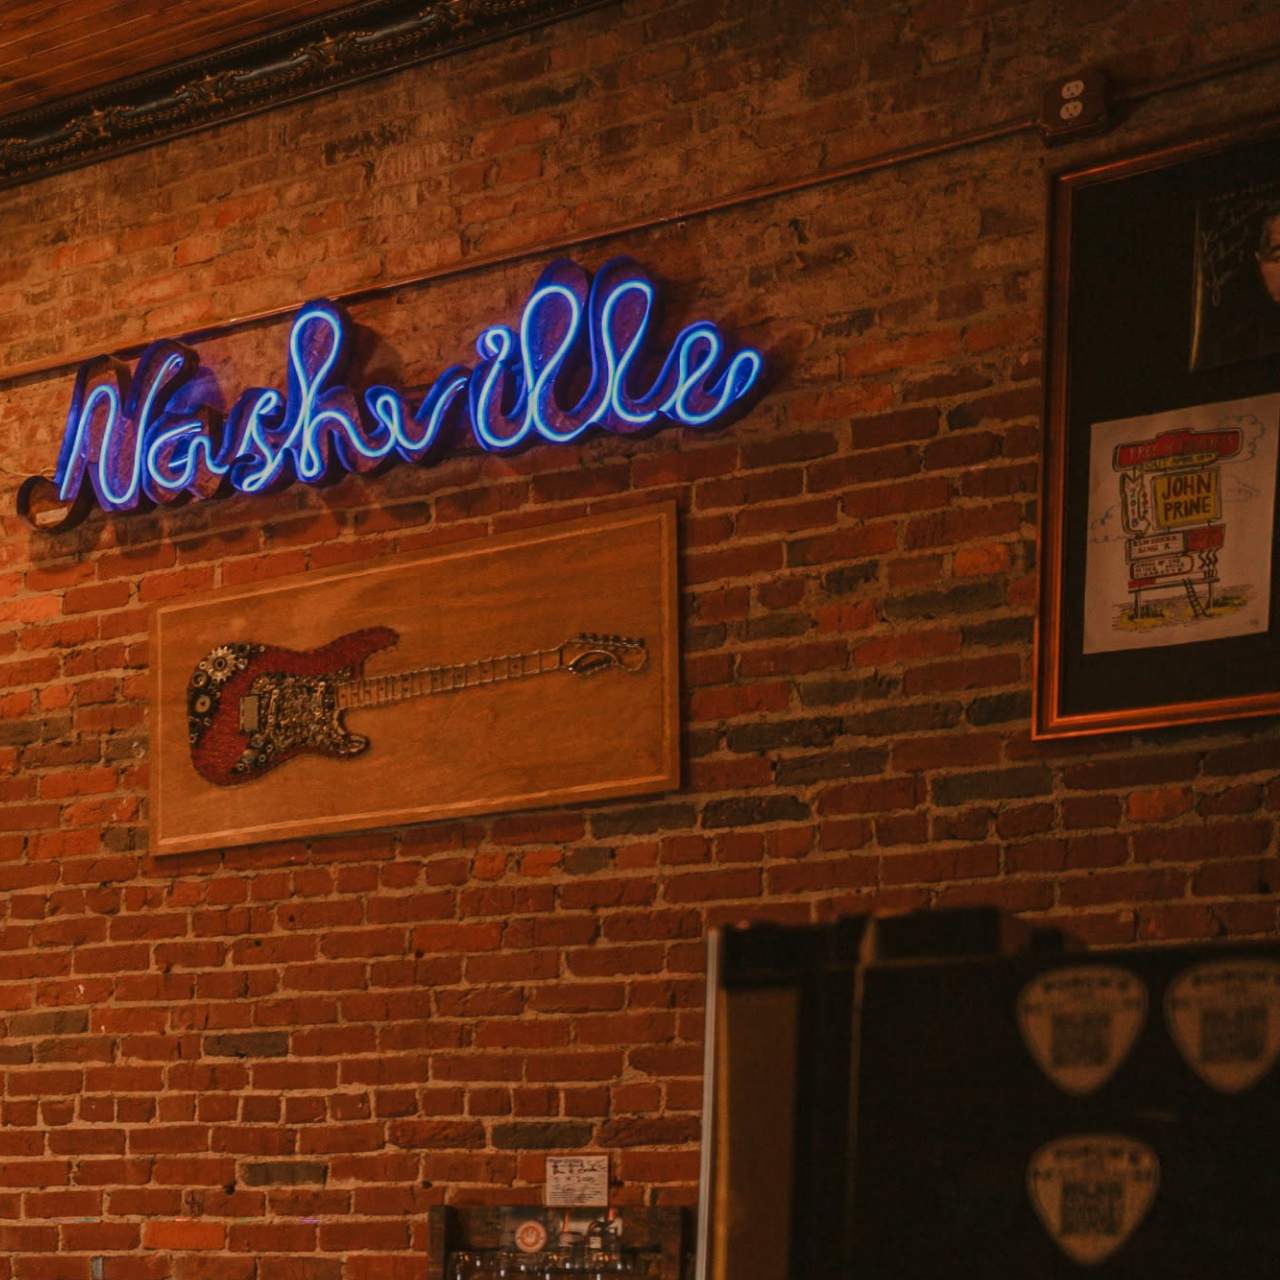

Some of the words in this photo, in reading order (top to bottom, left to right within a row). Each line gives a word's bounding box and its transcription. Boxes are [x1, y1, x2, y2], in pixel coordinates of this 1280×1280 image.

[55, 276, 765, 507] Nashville
[1161, 472, 1212, 500] JOHN
[1163, 496, 1213, 521] PRINE
